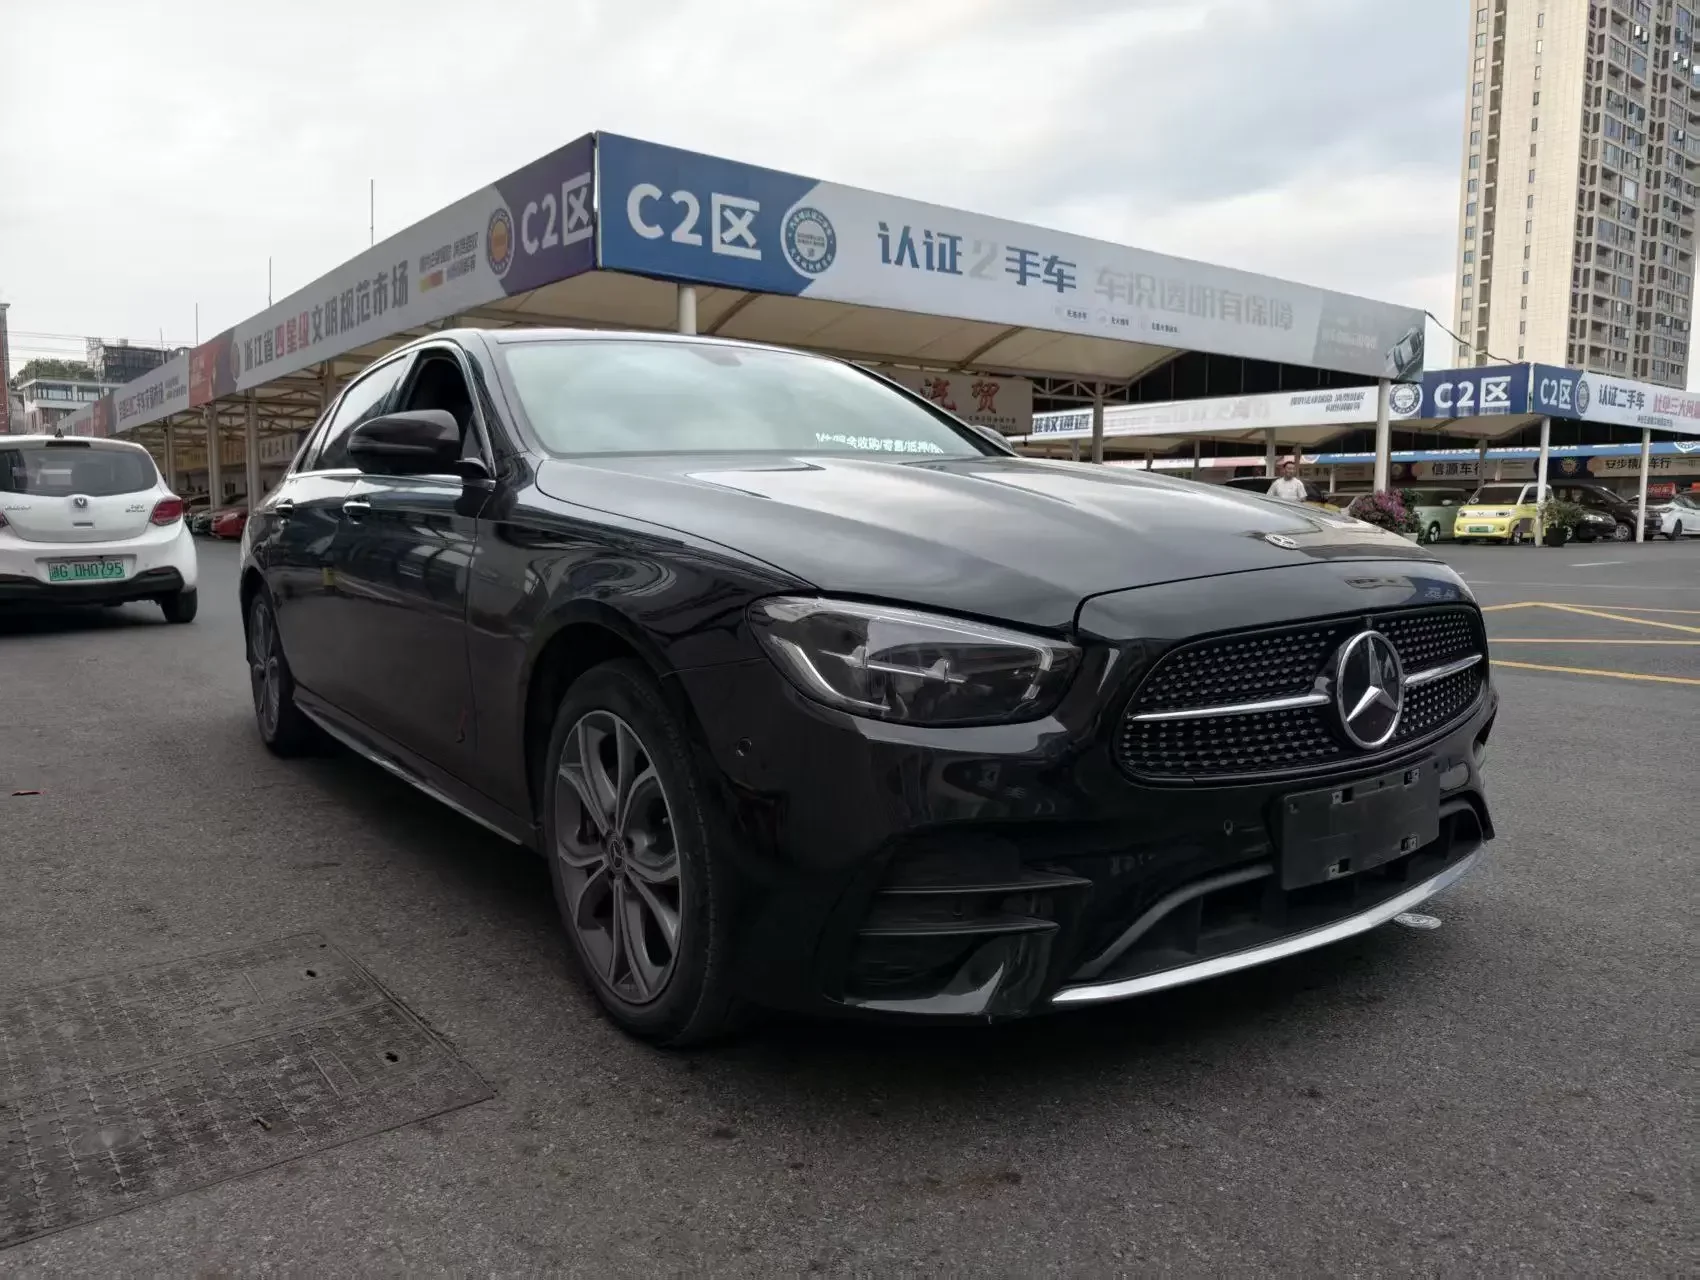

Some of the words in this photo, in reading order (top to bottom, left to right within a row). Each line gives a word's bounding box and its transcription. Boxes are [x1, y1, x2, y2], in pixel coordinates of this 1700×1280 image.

[521, 171, 593, 256] C2区
[626, 183, 762, 261] C2区
[1433, 375, 1512, 408] C2区
[1540, 377, 1573, 409] C2区
[1598, 383, 1646, 411] 认证二手车
[1605, 456, 1672, 471] 安步精车行
